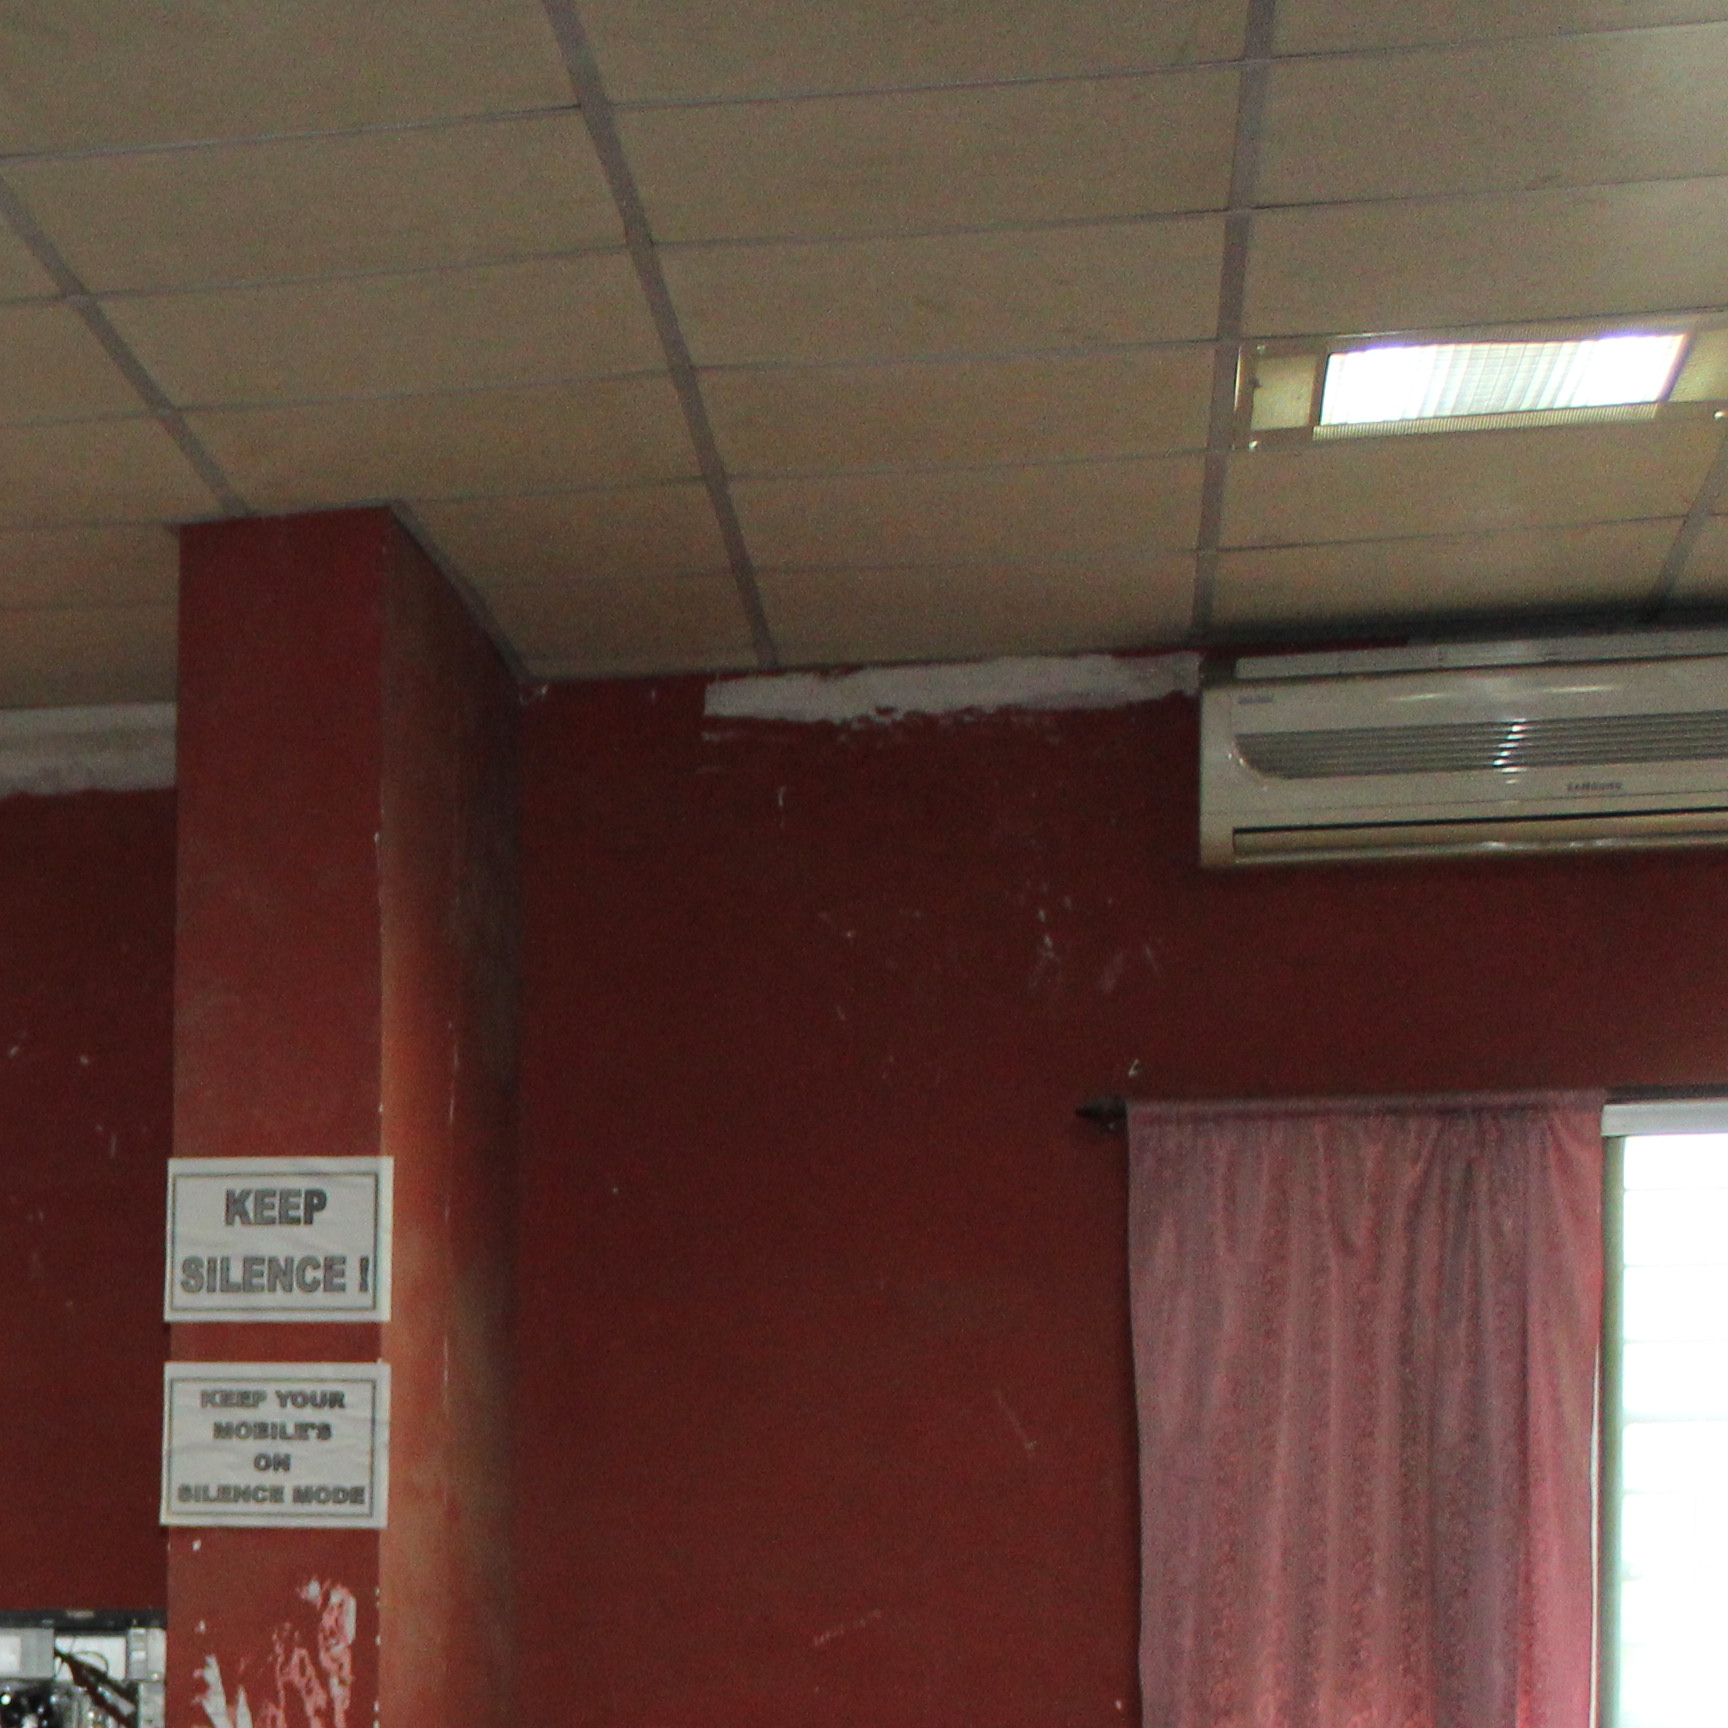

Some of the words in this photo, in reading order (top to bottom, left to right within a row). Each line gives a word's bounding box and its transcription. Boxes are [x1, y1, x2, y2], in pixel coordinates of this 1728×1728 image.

[224, 1188, 328, 1226] KEEP
[180, 1255, 347, 1293] SILENCE
[200, 1390, 267, 1409] KEEP
[275, 1390, 346, 1409] YOUR
[213, 1421, 332, 1440] MOBILE'S
[253, 1453, 291, 1471] ON
[178, 1484, 285, 1503] SILENCE
[292, 1485, 366, 1505] MODE
